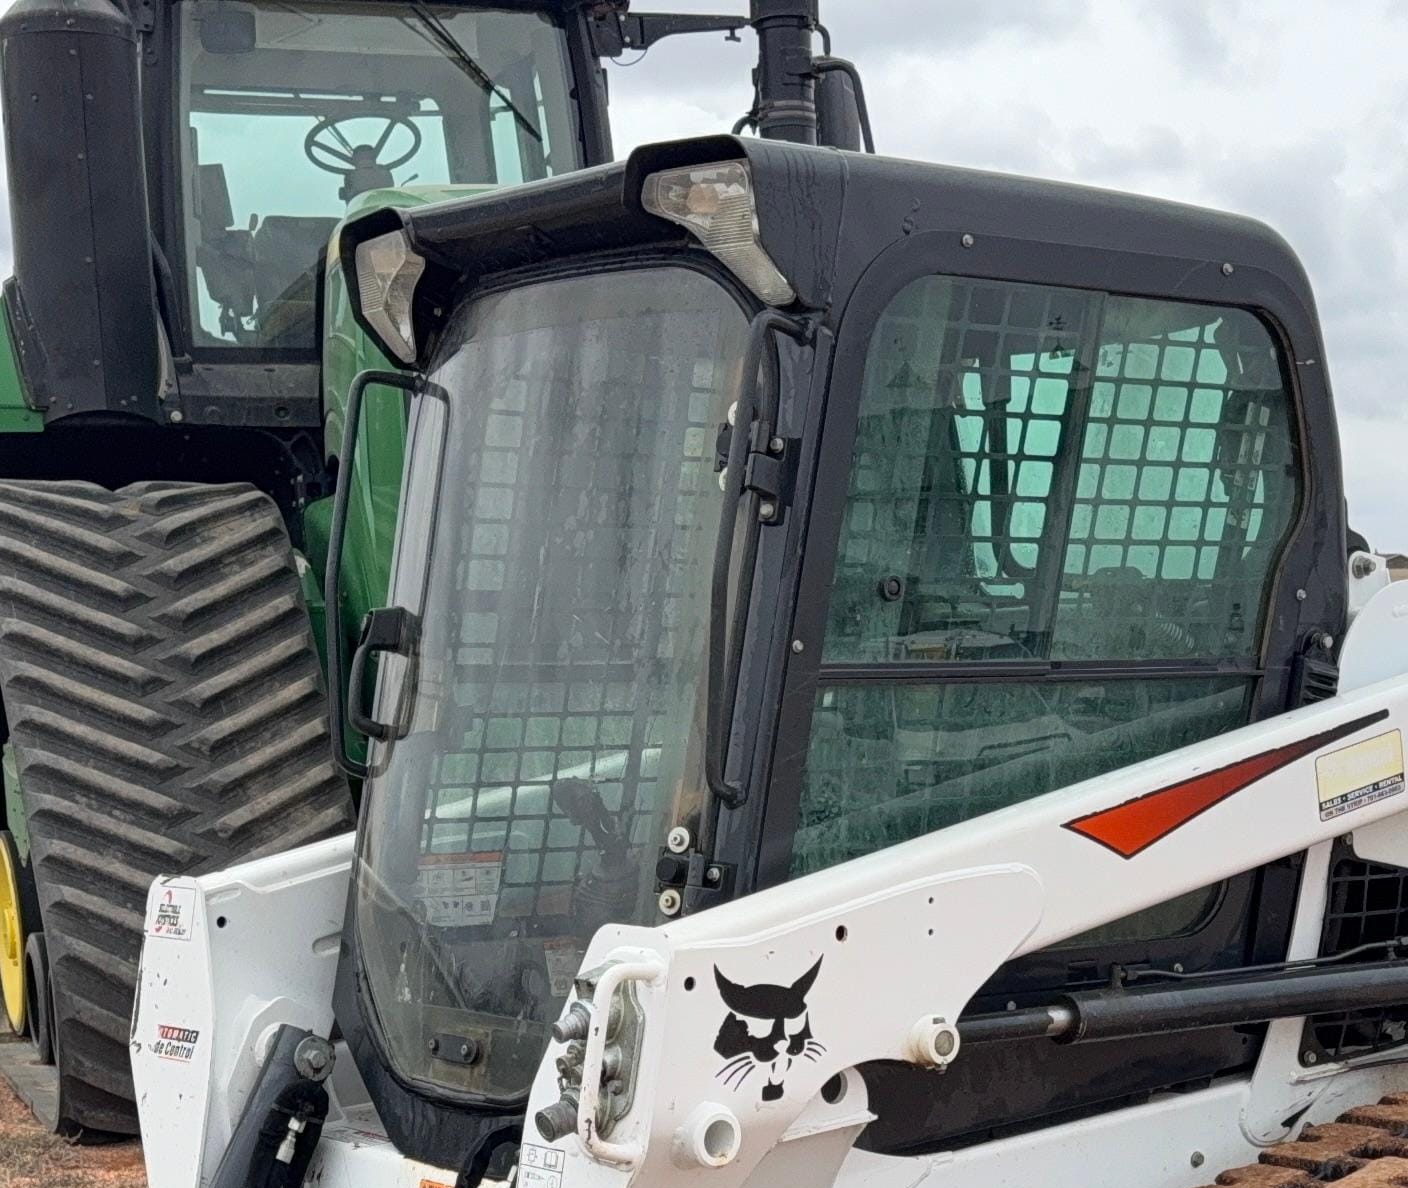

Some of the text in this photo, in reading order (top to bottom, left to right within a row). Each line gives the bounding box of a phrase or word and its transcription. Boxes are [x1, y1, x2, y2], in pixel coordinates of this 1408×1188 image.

[1347, 785, 1373, 800] SERVICE
[1379, 775, 1402, 790] RENTAL
[165, 1041, 195, 1059] Control
